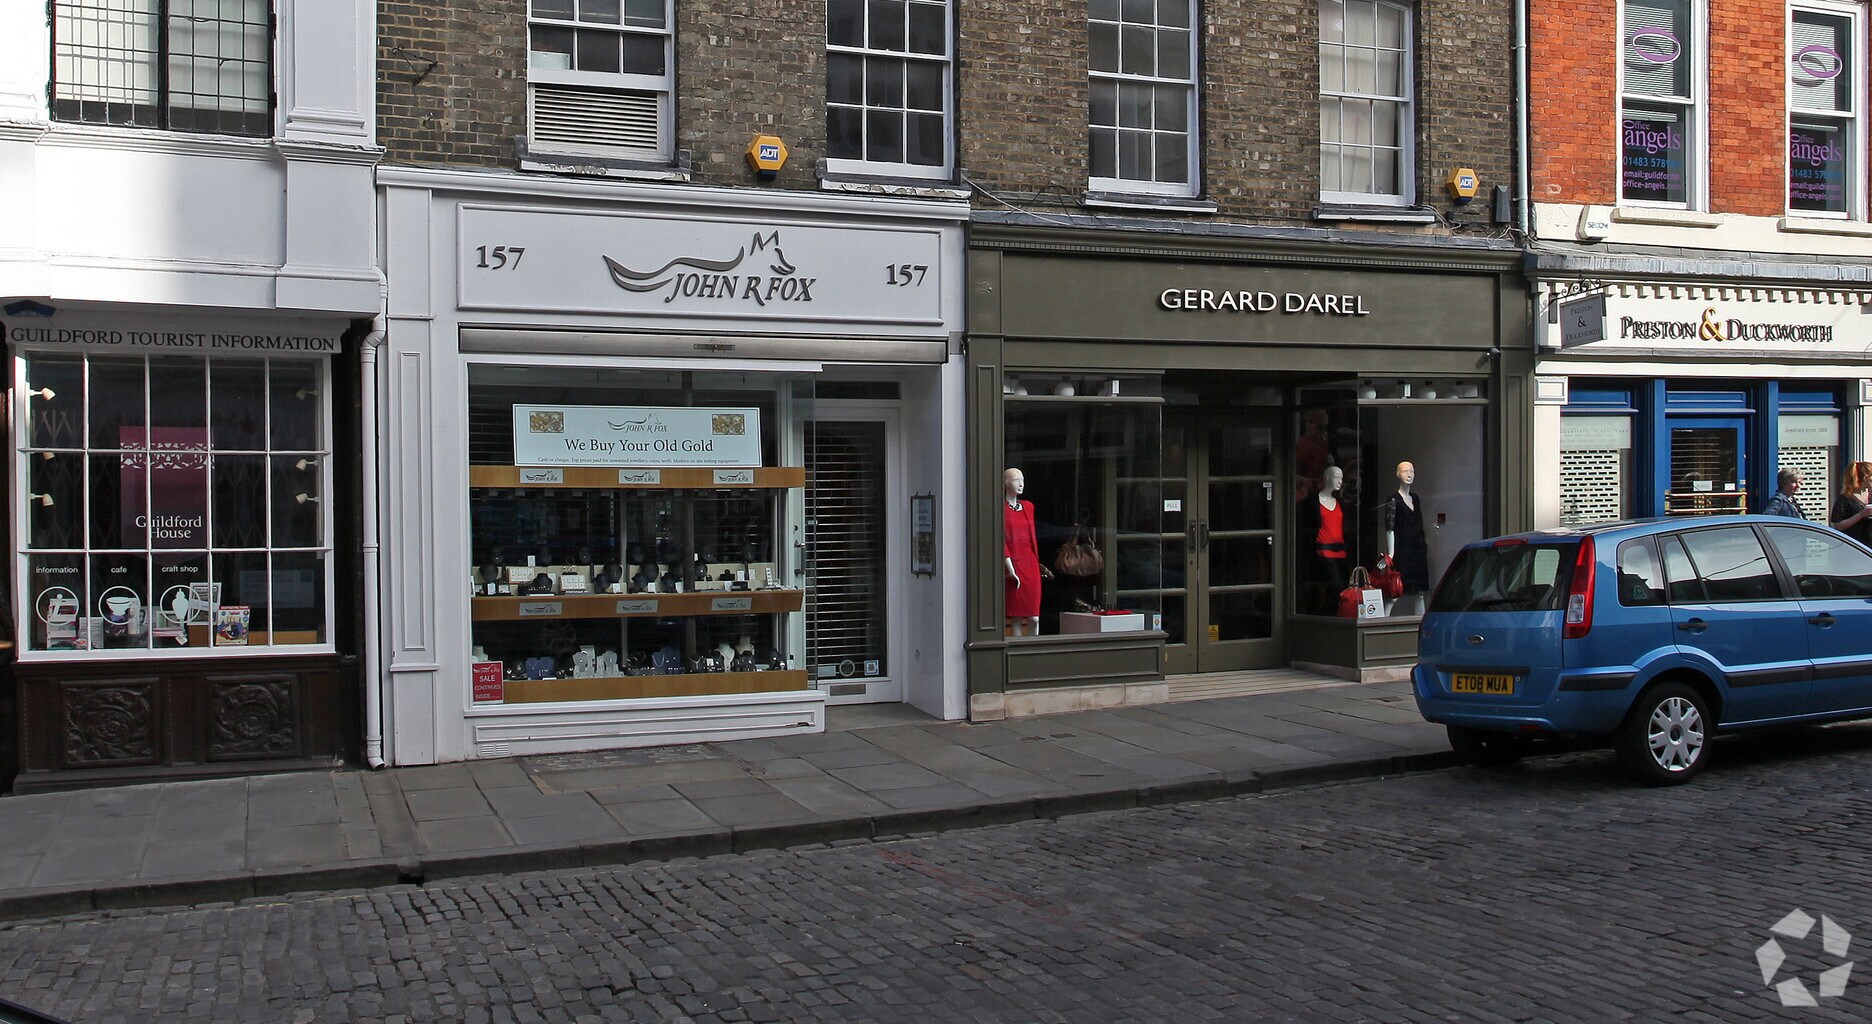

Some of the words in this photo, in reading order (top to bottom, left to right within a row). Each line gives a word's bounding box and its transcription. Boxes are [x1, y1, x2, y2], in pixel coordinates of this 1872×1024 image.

[1624, 126, 1681, 154] angels
[760, 148, 779, 158] ADT
[1623, 156, 1648, 167] 01483
[1791, 140, 1843, 166] angels
[475, 245, 526, 271] 157
[886, 263, 929, 287] 157
[664, 273, 740, 303] JOHN
[742, 275, 766, 307] R
[764, 277, 817, 302] FOX
[1160, 288, 1278, 312] GERARD
[1285, 292, 1370, 315] DAREL
[1577, 316, 1587, 327] &
[1619, 315, 1697, 339] PRESTON
[1698, 306, 1728, 342] &
[1725, 318, 1833, 343] DUCKWORTH
[11, 327, 123, 344] GUILDFORD
[127, 331, 206, 347] TOURIST
[211, 334, 335, 351] INFORMATION
[564, 438, 586, 451] We
[590, 439, 615, 455] Buy
[619, 439, 650, 451] Your
[653, 439, 678, 452] Old
[681, 439, 714, 452] Gold
[35, 565, 78, 573] information
[110, 565, 128, 573] cafe
[161, 565, 179, 573] craft
[180, 564, 199, 575] shop
[479, 675, 496, 683] SALE
[1456, 675, 1484, 691] ET08
[1486, 677, 1508, 692] MUA
